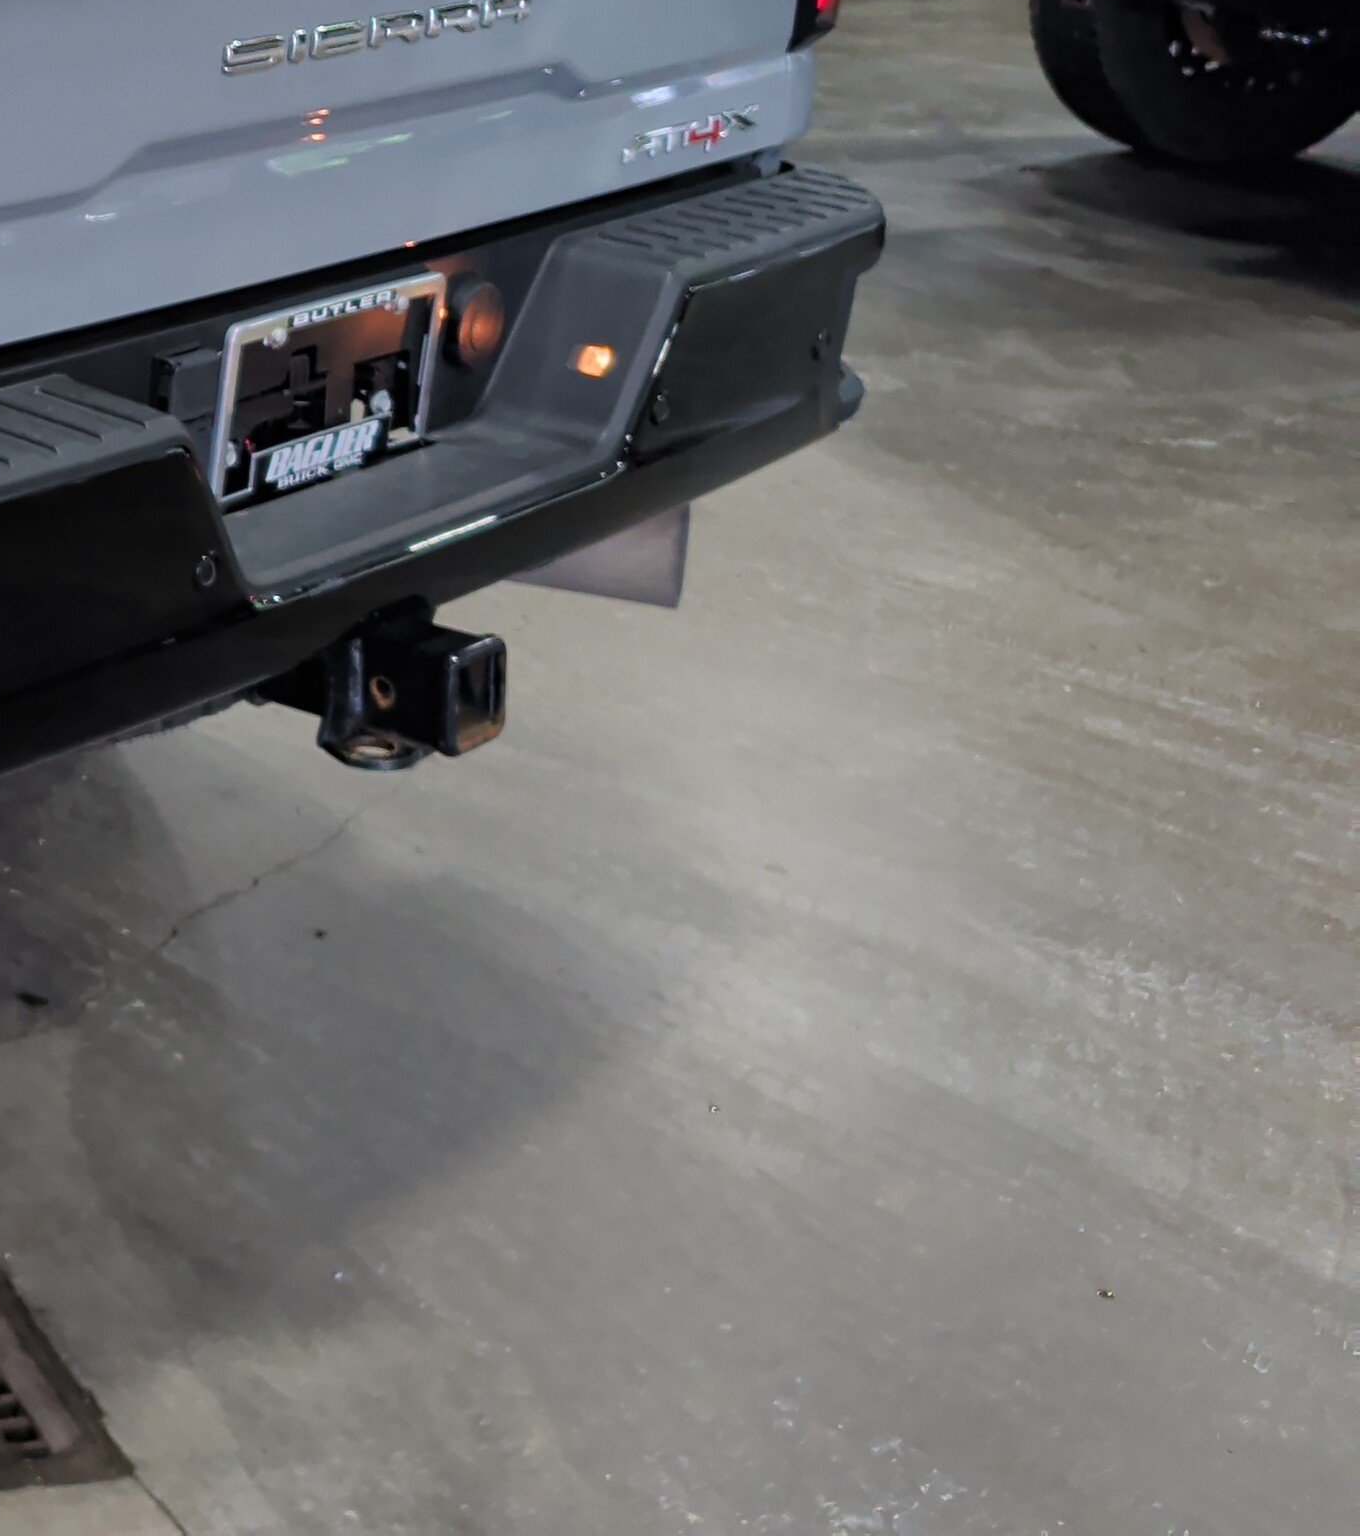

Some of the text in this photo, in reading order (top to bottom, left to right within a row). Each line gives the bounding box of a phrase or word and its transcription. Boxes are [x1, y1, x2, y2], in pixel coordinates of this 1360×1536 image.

[621, 103, 760, 164] AT4X
[292, 289, 393, 328] BUTLER
[265, 419, 380, 482] BAGLIER
[277, 452, 363, 490] BUICK GMC
